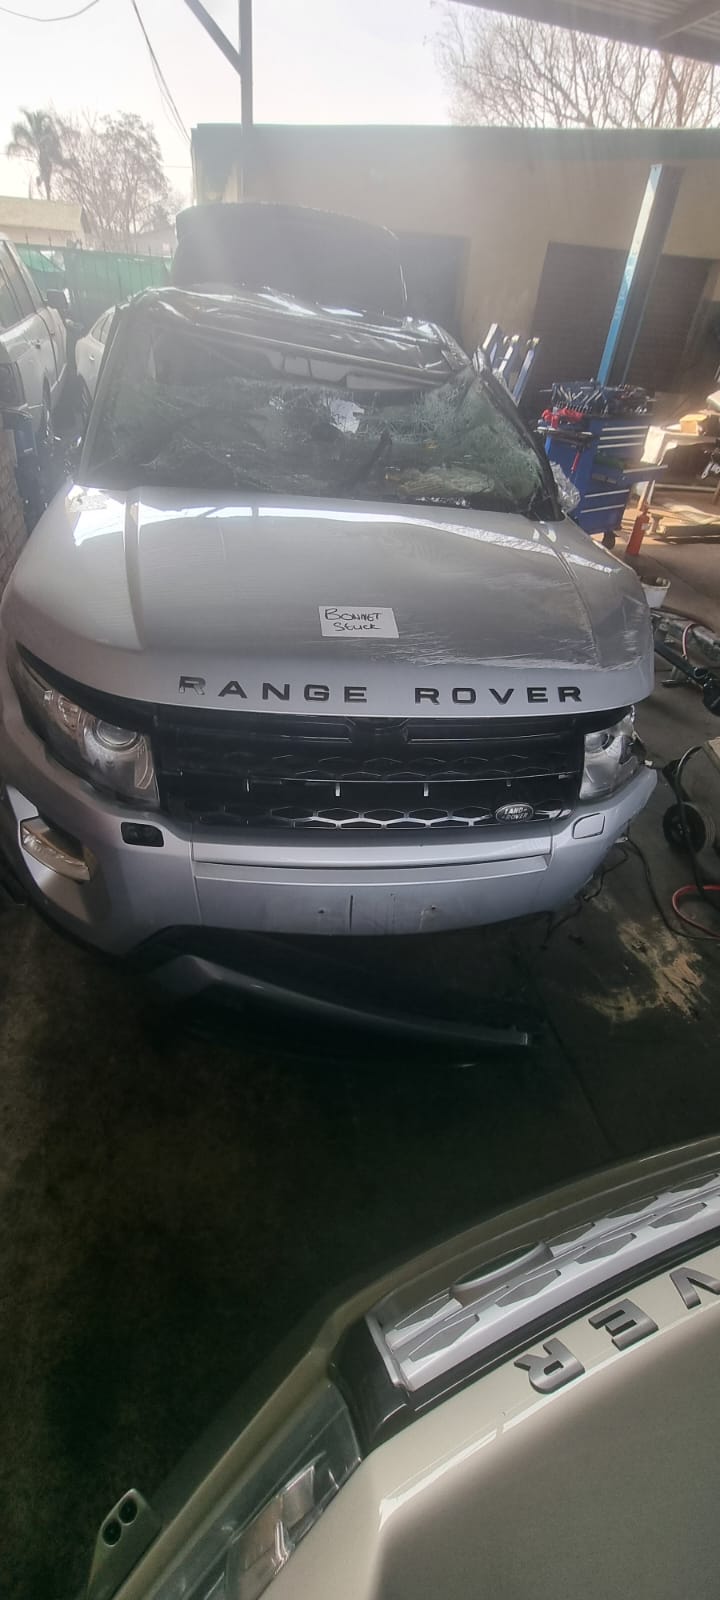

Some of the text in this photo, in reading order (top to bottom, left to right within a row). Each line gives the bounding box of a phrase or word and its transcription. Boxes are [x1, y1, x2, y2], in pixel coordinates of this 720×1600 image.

[325, 607, 381, 621] BONNET
[178, 676, 582, 705] RANGE ROVER
